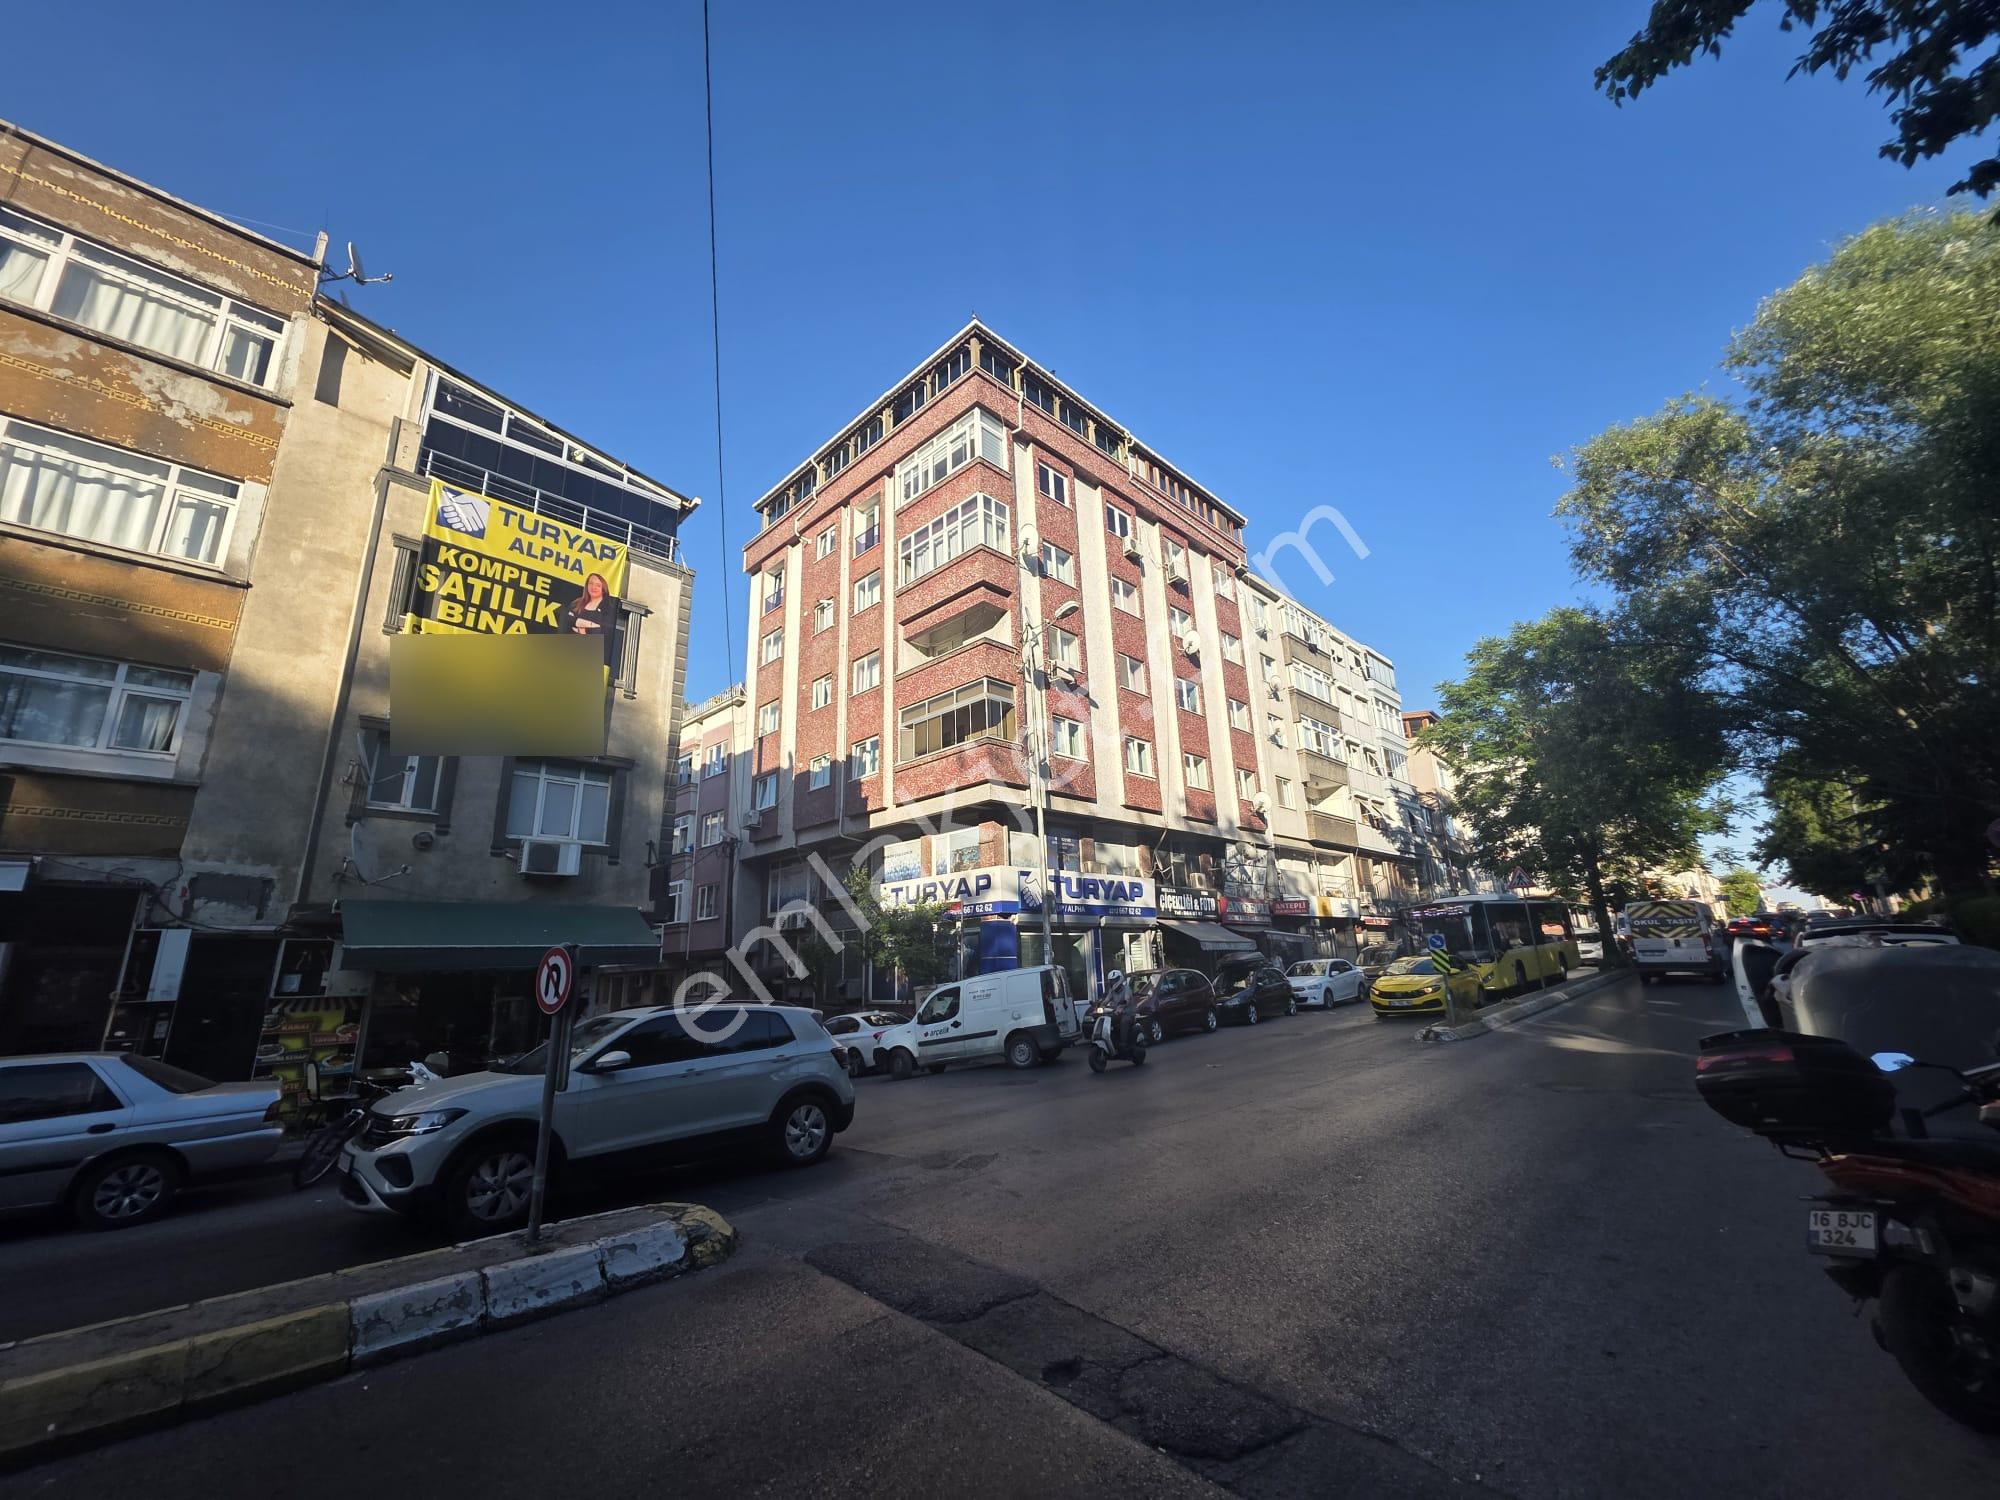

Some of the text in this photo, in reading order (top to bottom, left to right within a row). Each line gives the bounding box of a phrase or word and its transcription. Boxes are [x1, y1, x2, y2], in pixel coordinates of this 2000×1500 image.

[498, 508, 617, 562] TURYAP
[438, 546, 552, 596] KOMPLE
[508, 537, 584, 575] ALPHA
[418, 563, 562, 628] SATILIK
[891, 874, 992, 906] TURYAP
[1048, 875, 1144, 902] TURYAP
[1633, 918, 1661, 926] OKUL
[1812, 1212, 1872, 1229] 16 BJC
[1823, 1229, 1857, 1245] 324
